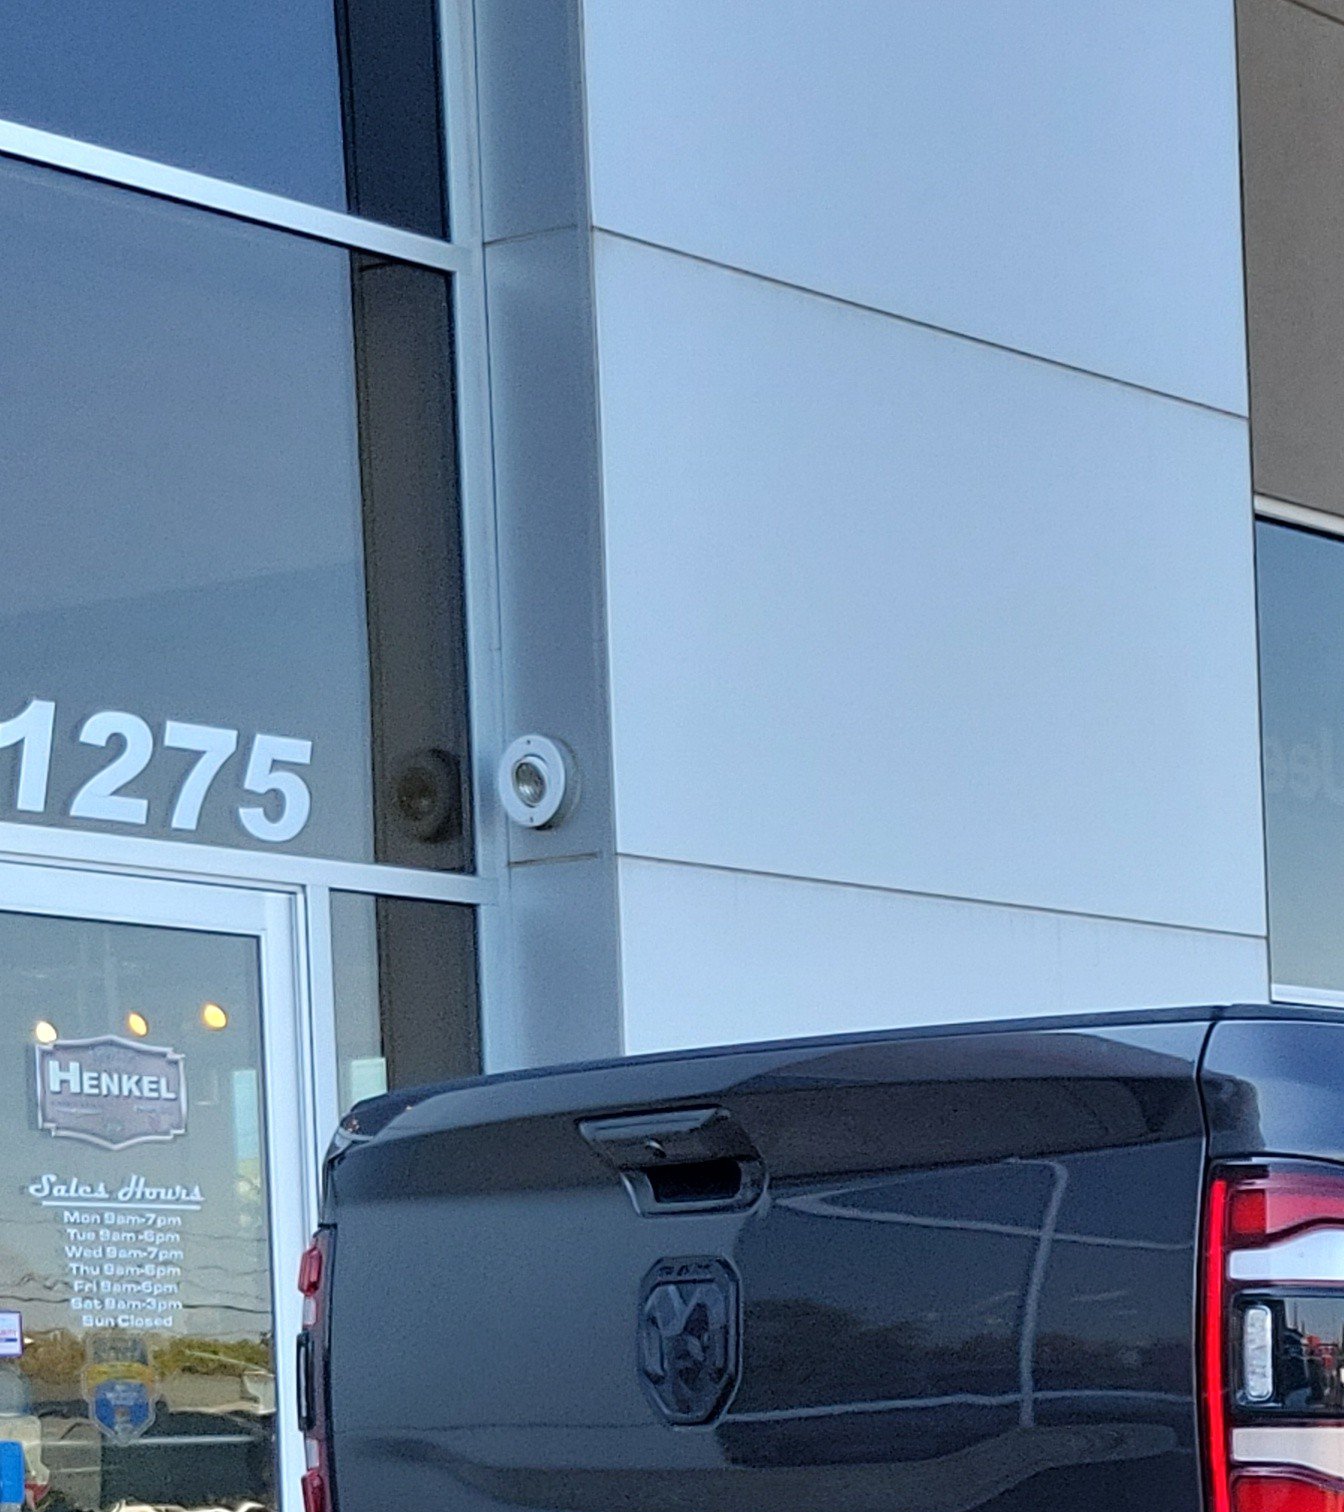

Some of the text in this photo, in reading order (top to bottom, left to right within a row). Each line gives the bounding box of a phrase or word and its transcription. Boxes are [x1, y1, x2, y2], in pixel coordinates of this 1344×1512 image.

[0, 699, 312, 843] 1275
[48, 1060, 177, 1100] HENKEL
[29, 1172, 206, 1201] Sales Hours
[63, 1210, 100, 1224] Mon
[66, 1228, 95, 1241] Tue
[65, 1245, 102, 1259] Wed
[69, 1262, 100, 1276] Thu
[74, 1280, 97, 1294] Fri
[71, 1296, 102, 1310] Sat
[82, 1314, 173, 1328] Sun Closed
